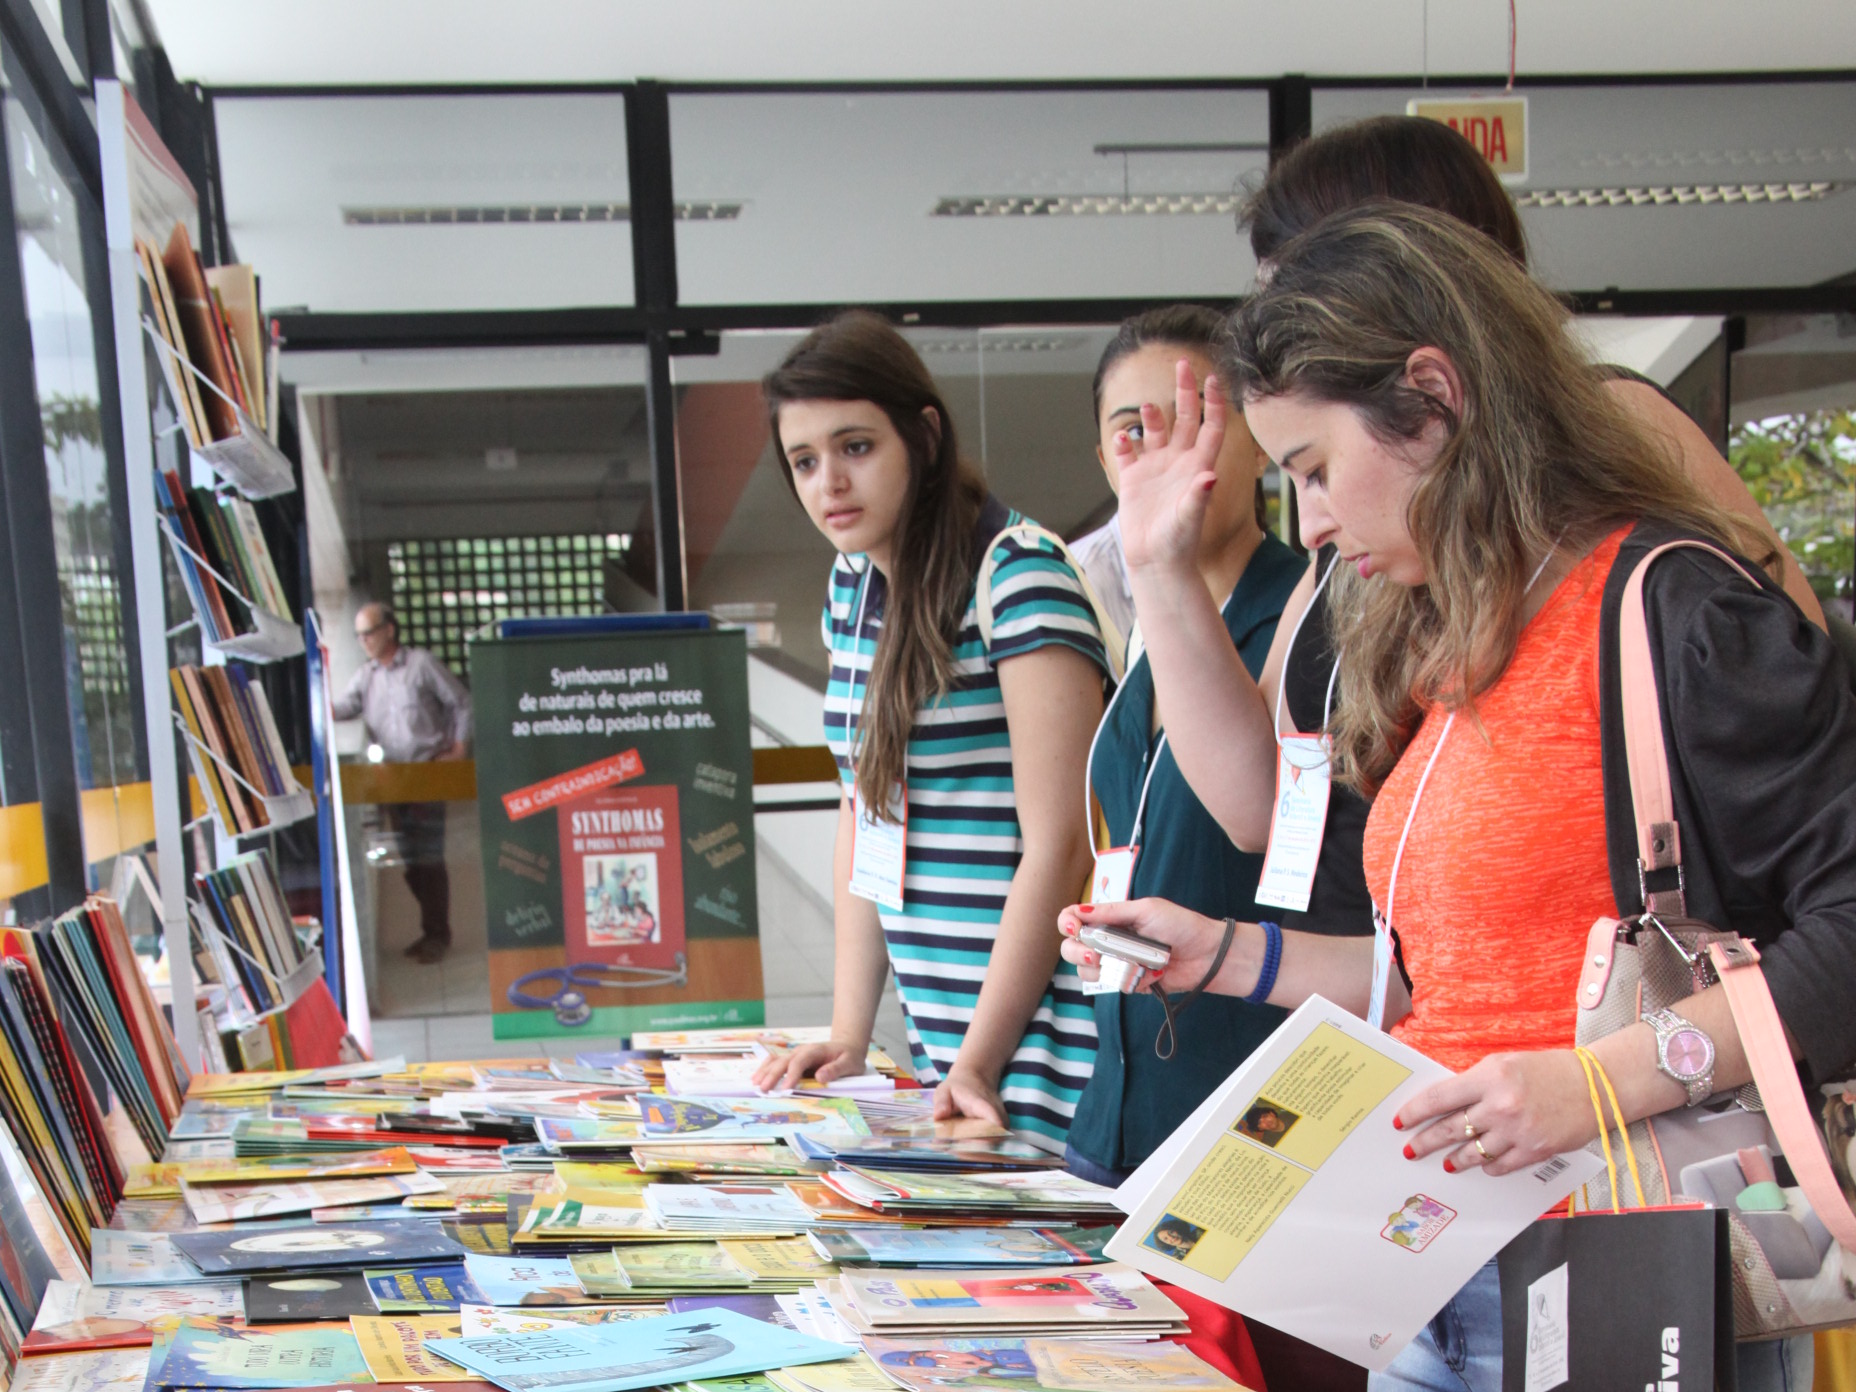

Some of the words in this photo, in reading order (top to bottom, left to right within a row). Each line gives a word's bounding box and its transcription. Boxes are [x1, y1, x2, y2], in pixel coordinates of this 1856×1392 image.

[551, 666, 627, 690] Synthomas
[629, 665, 653, 688] pra
[654, 662, 669, 682] lá
[519, 692, 538, 712] de
[539, 690, 596, 710] naturais
[597, 689, 615, 709] de
[617, 690, 657, 712] quem
[658, 689, 703, 706] cresce
[512, 720, 531, 737] ao
[532, 714, 584, 736] embalo
[585, 713, 604, 734] da
[605, 711, 650, 738] poesia
[652, 714, 661, 730] e
[662, 710, 681, 729] da
[508, 796, 533, 814] SEM
[1279, 790, 1291, 819] 6
[571, 807, 664, 835] SYNTHOMAS
[881, 1298, 908, 1308] O
[506, 1333, 591, 1359] FANTE
